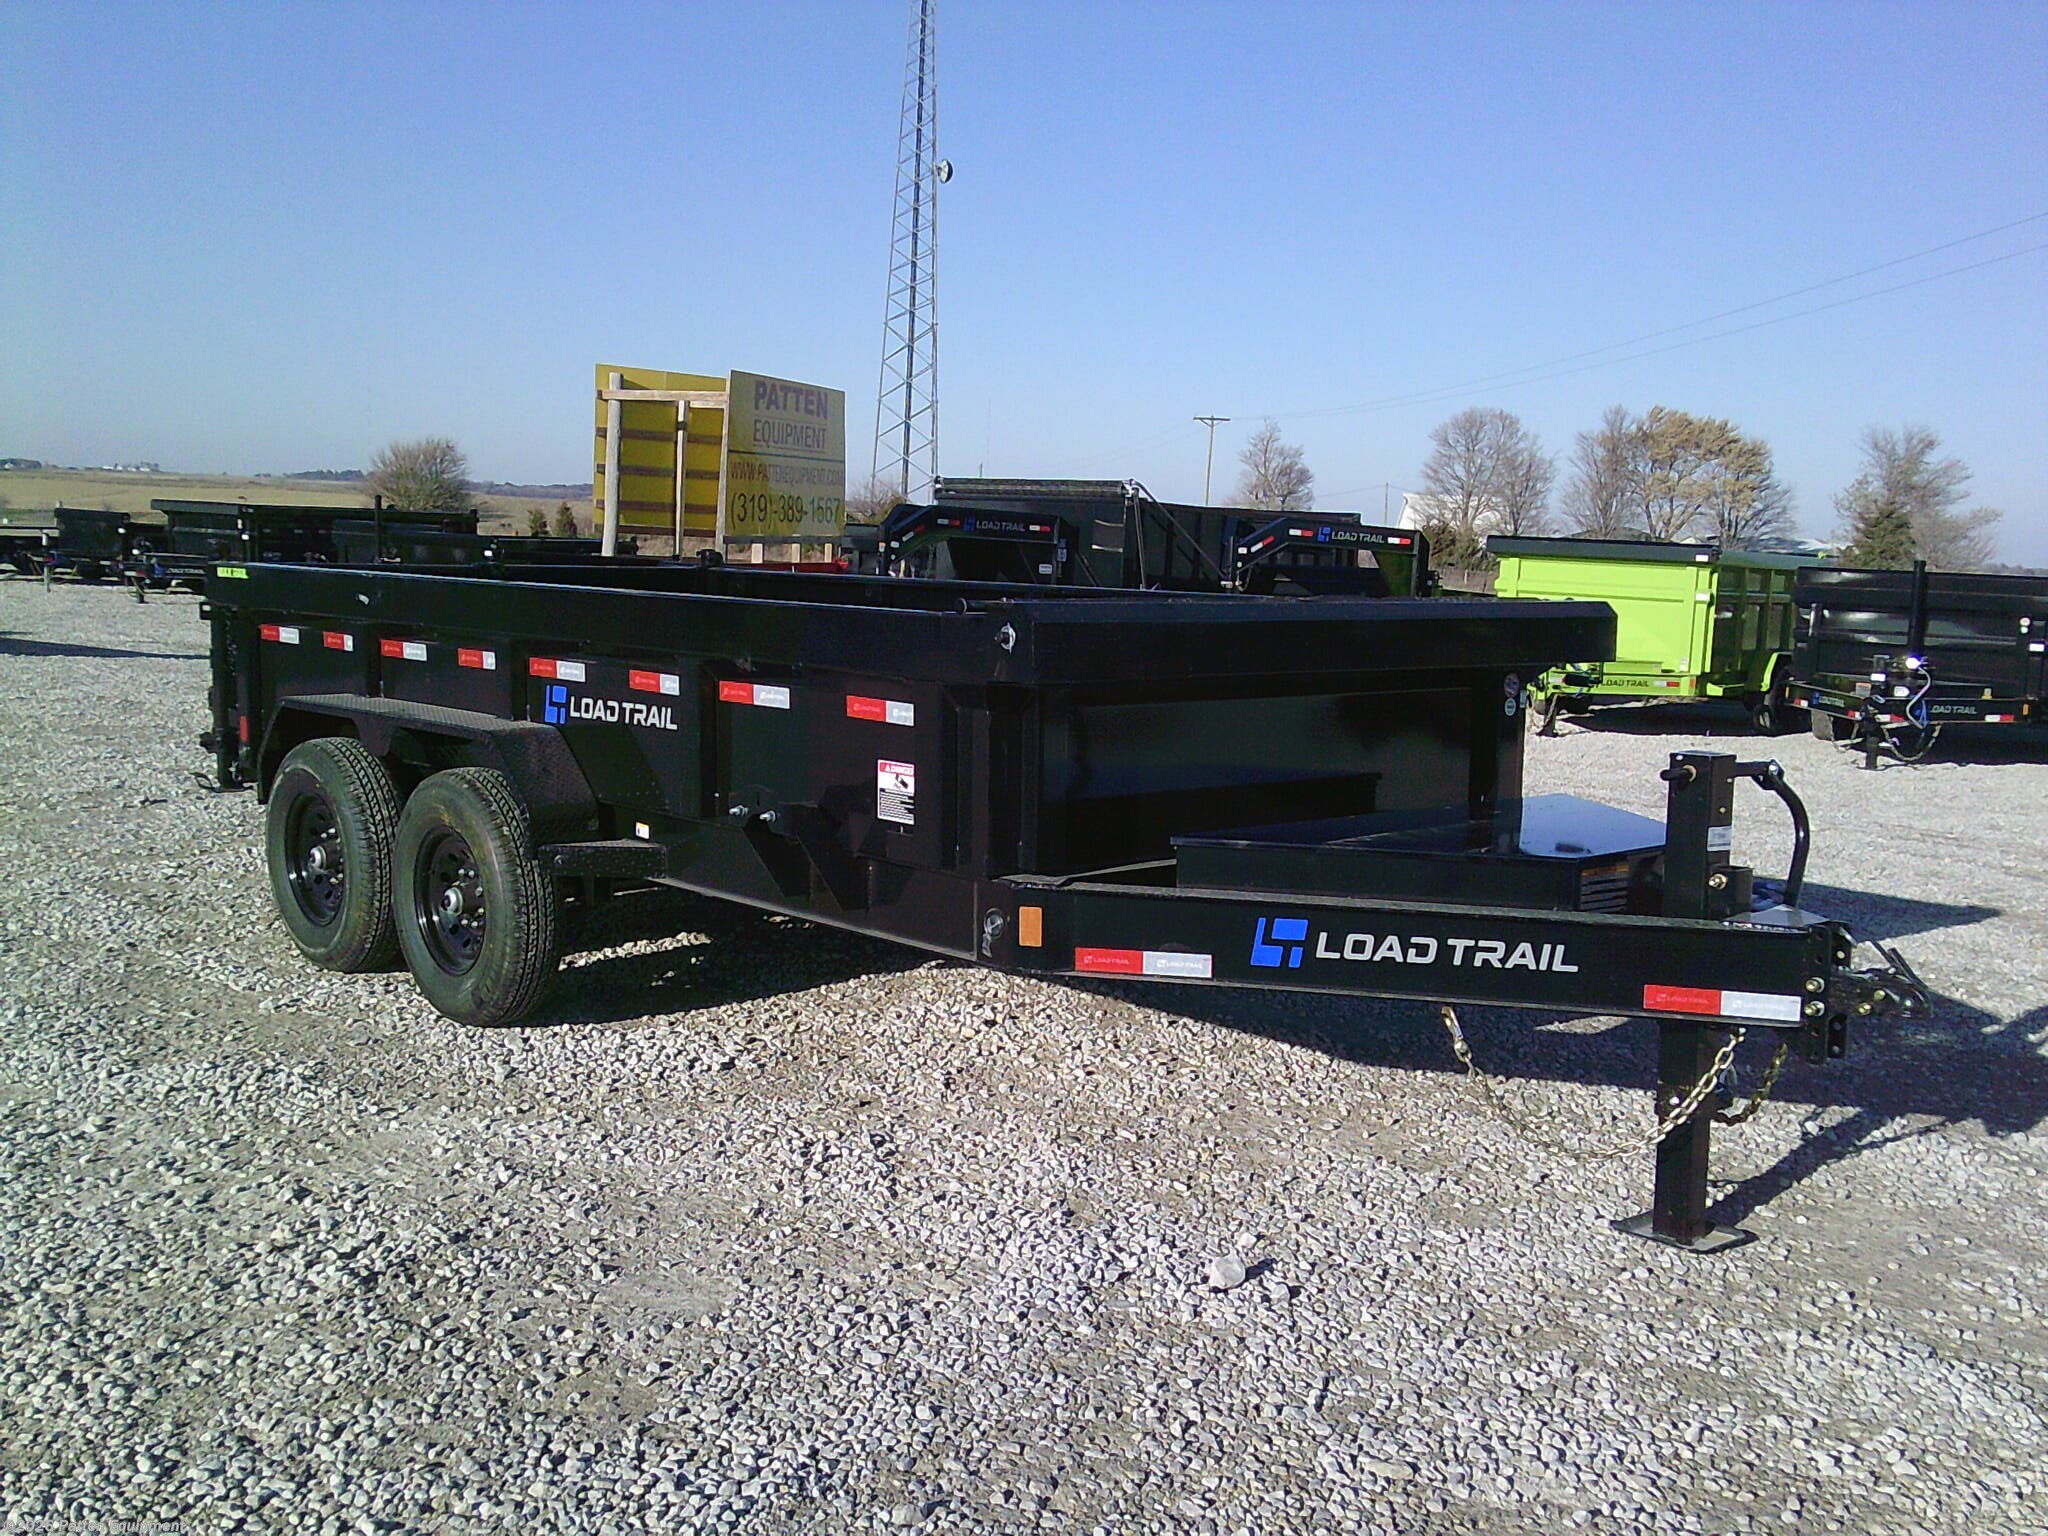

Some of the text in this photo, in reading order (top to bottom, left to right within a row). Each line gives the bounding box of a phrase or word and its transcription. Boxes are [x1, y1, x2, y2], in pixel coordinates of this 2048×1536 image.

[754, 381, 828, 419] PATTEN
[753, 419, 827, 449] EQUIPMENT
[976, 520, 1025, 532] LOAD TRAIL
[1331, 530, 1385, 544] LOAD TRAIL
[570, 695, 678, 730] LOAD TRAIL
[1315, 931, 1579, 973] LOAD TRAIL
